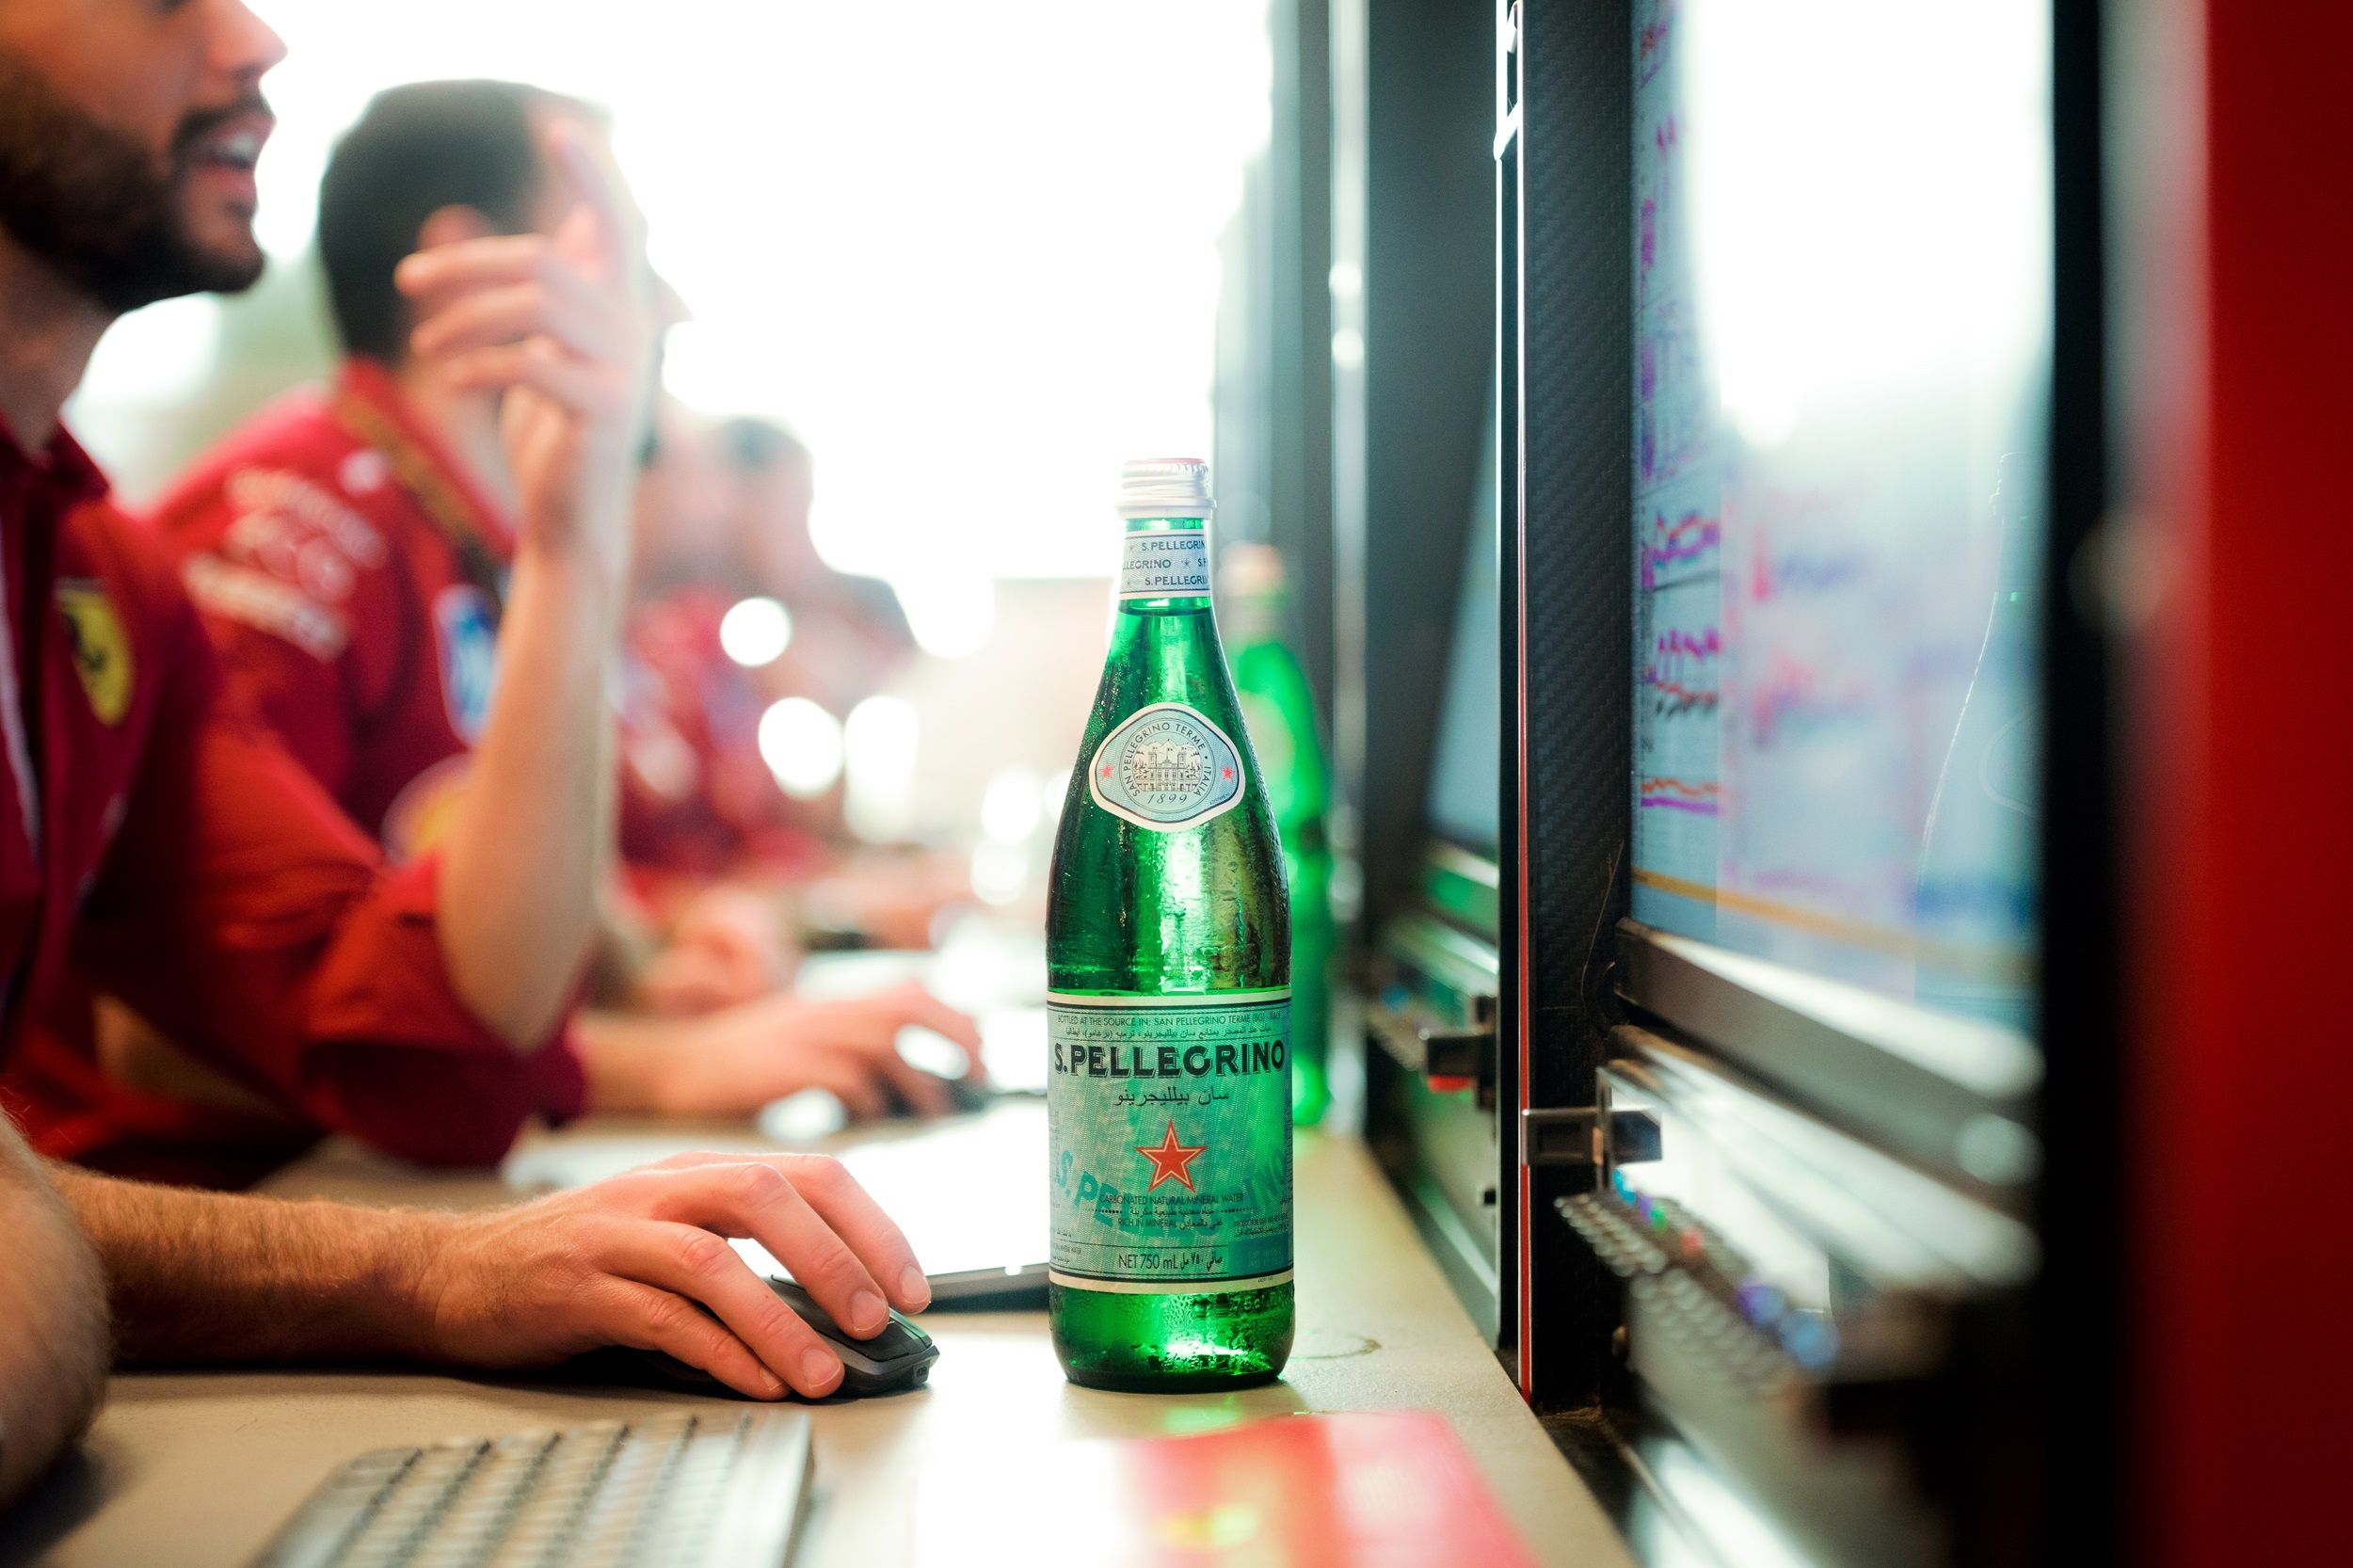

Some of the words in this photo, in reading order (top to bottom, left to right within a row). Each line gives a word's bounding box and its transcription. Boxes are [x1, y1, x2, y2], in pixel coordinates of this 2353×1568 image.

[1176, 723, 1206, 750] TERME
[1123, 722, 1171, 772] PELLEGRINO
[1125, 776, 1141, 797] SAN
[1193, 765, 1212, 797] ITALIA
[1146, 793, 1188, 805] 1899
[1080, 1016, 1088, 1025] AT
[1089, 1016, 1101, 1026] THE
[1103, 1017, 1136, 1027] SOURCE
[1154, 1017, 1174, 1026] SAN
[1176, 1016, 1226, 1026] PELLEGRINO
[1228, 1014, 1250, 1024] TERME
[1054, 1039, 1285, 1079] S.PELLEGRINO
[1113, 1086, 1190, 1107] بيلليجرينو
[1197, 1087, 1229, 1106] سان
[1098, 1194, 1148, 1205] CARBONATED
[1149, 1194, 1185, 1206] NATURAL
[1187, 1194, 1220, 1205] MINERAL
[1222, 1193, 1244, 1203] WATER
[1145, 1218, 1177, 1228] MINERAL
[1118, 1253, 1139, 1269] NET
[1140, 1253, 1160, 1270] 750
[1162, 1254, 1178, 1270] mL
